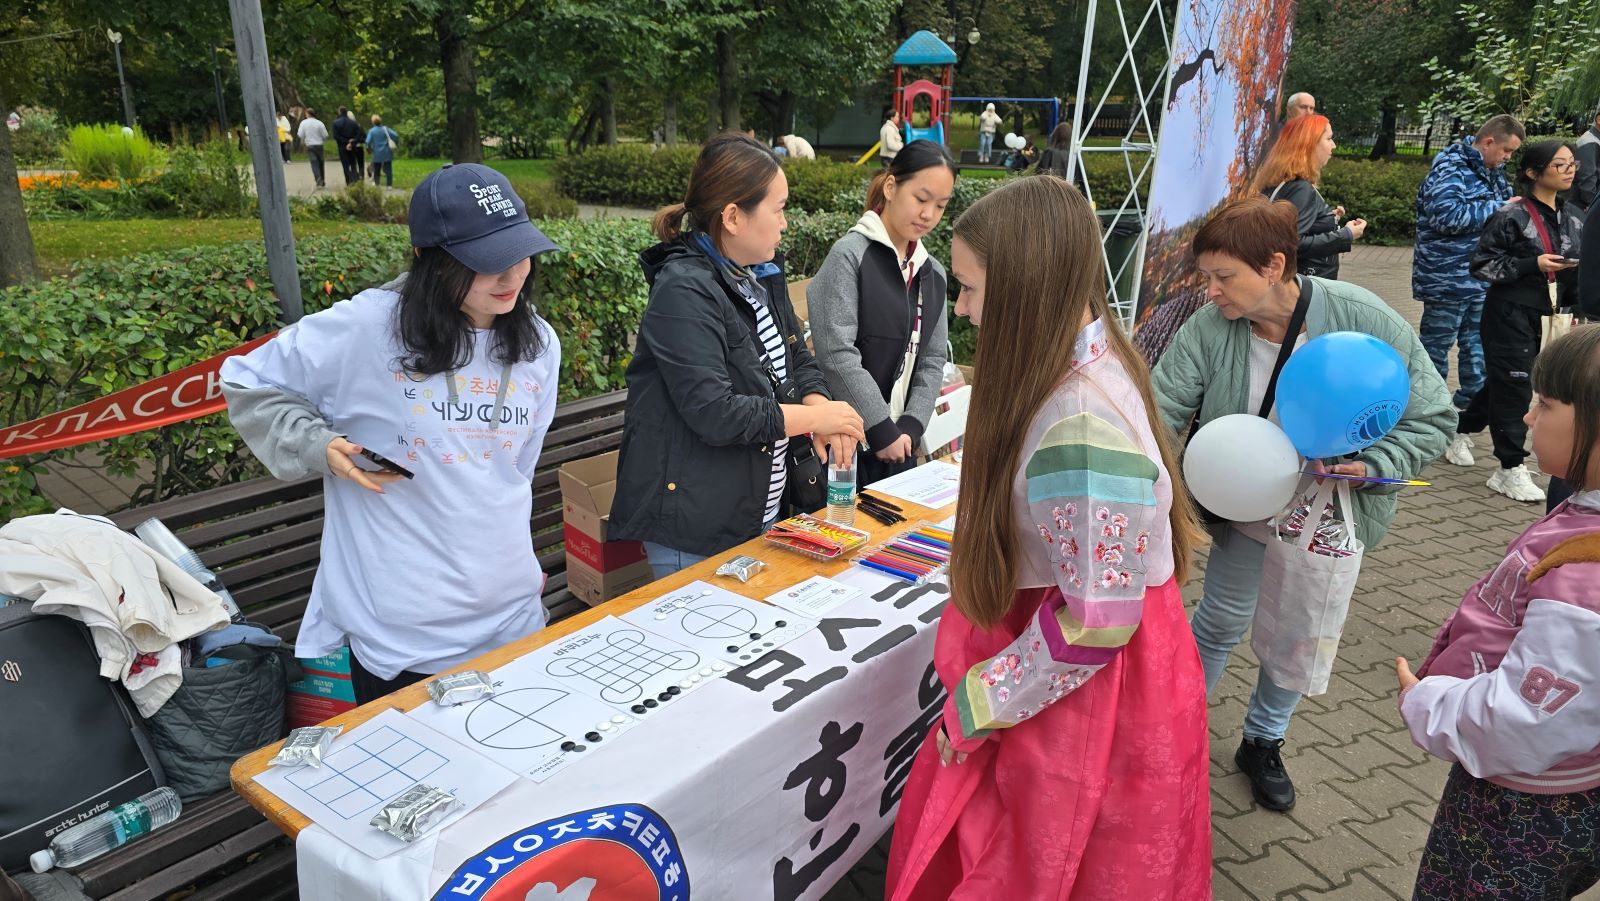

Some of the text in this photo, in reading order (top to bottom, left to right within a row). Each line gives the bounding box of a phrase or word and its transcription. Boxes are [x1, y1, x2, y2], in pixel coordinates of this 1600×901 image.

[470, 184, 501, 198] SPORT
[503, 208, 517, 217] CLUB
[1520, 666, 1582, 716] 87
[45, 818, 78, 838] arctic
[78, 800, 110, 822] hunter
